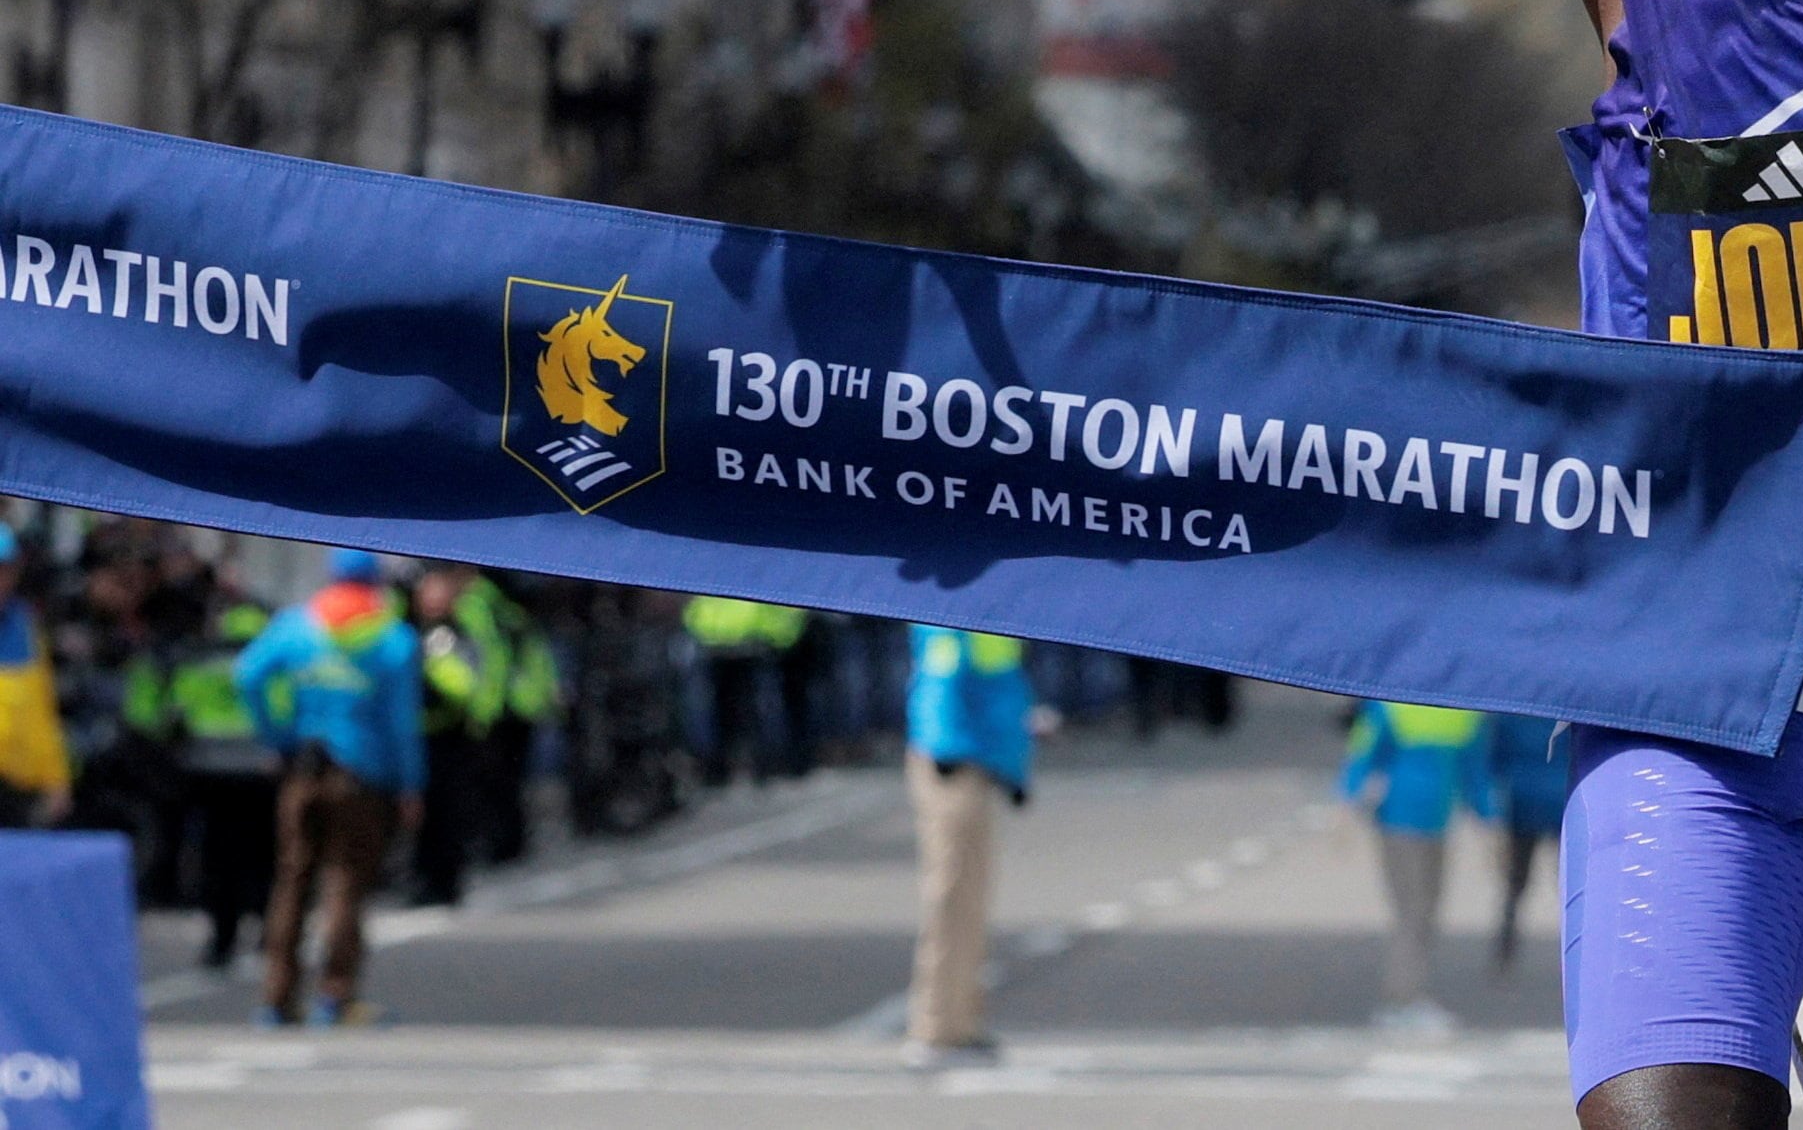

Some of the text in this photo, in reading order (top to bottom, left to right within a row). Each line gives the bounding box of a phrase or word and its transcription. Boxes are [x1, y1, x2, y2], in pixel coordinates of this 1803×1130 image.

[0, 234, 289, 346] RATHON
[708, 347, 1651, 538] 130TH BOSTON MARATHON
[715, 447, 1252, 554] BANK OF AMERICA
